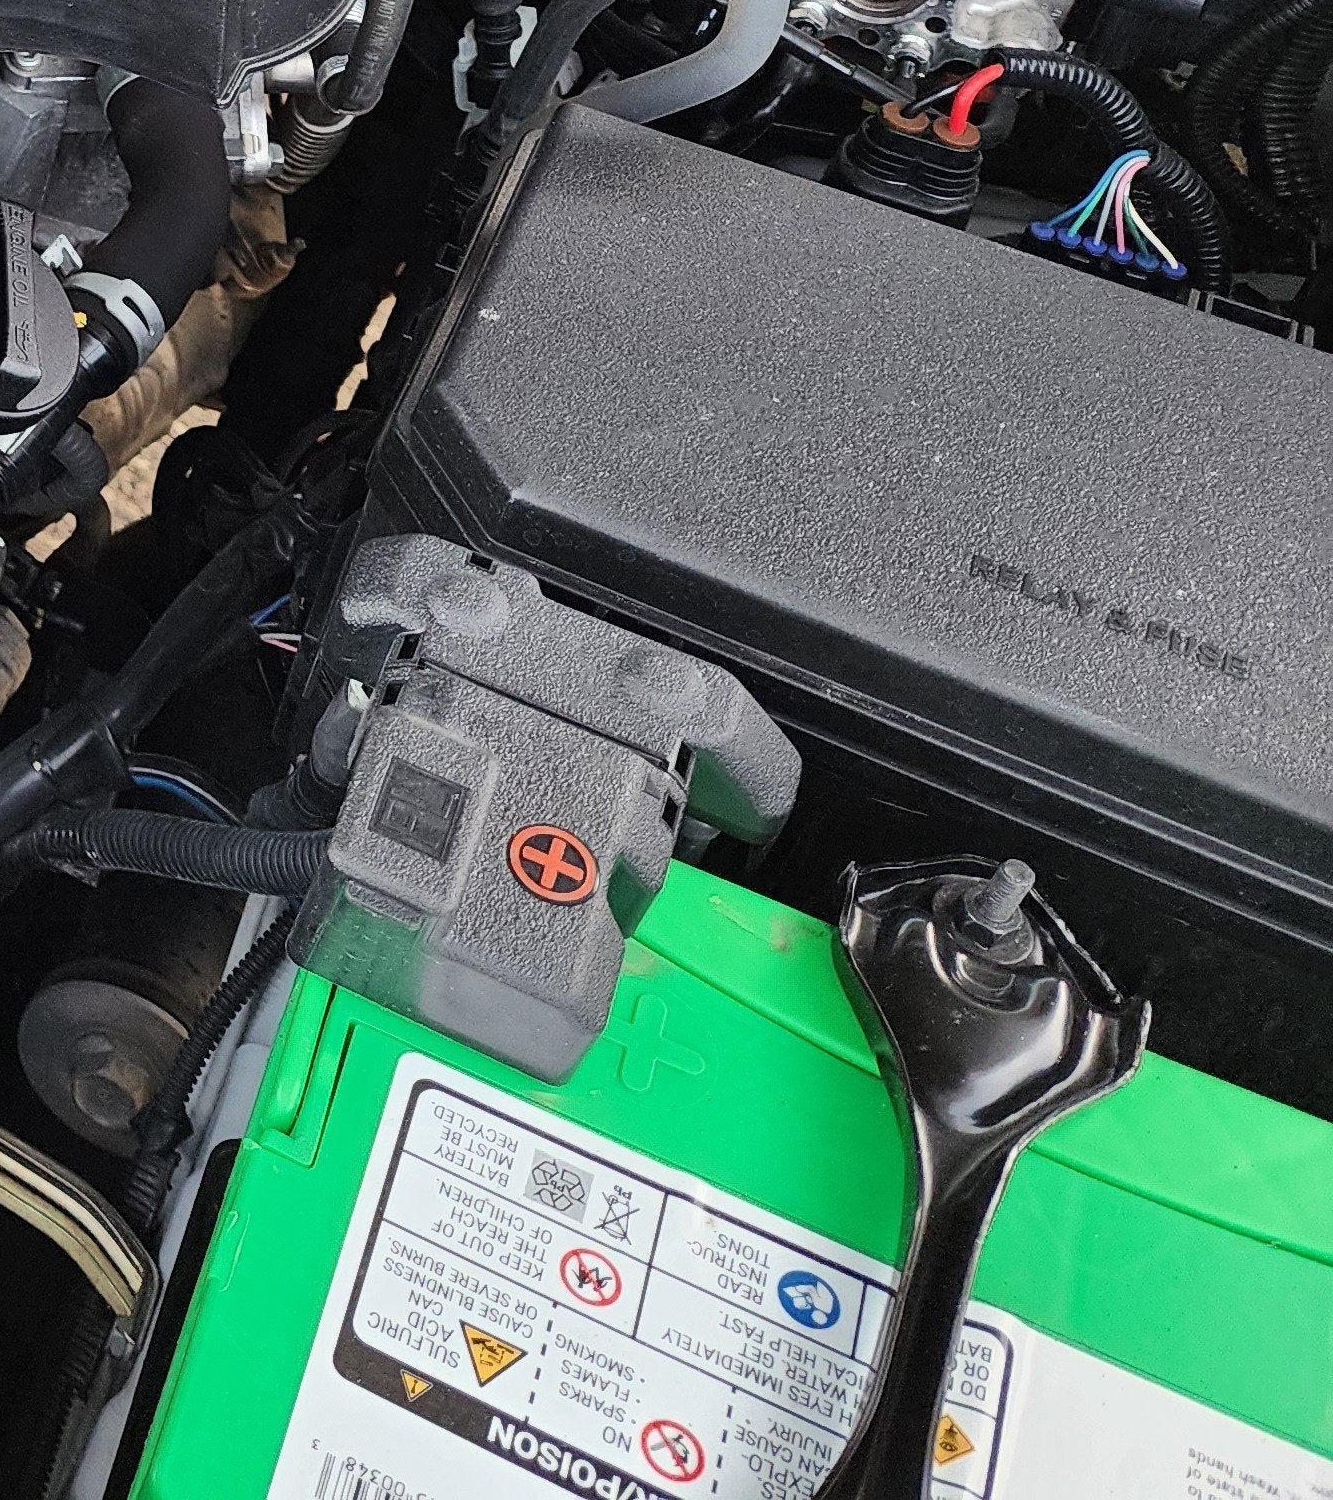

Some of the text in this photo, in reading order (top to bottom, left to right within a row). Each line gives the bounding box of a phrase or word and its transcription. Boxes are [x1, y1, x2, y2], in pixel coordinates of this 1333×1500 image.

[8, 206, 29, 307] ENGINE OIL
[968, 553, 1093, 615] RELAY
[431, 1102, 518, 1153] RECYCLED.
[440, 1125, 514, 1170] MUST BE
[433, 1144, 509, 1188] BATTERY
[436, 1179, 552, 1244] OF CHILDREN.
[430, 1219, 544, 1281] KEEP OUT OF
[451, 1206, 547, 1264] THE REACH
[713, 1226, 768, 1269] TIONS.
[388, 1237, 537, 1320] OR SEVERE BURNS.
[686, 1241, 767, 1287] INSTRUC-
[383, 1257, 533, 1338] CAUSE BLINDNESS
[408, 1289, 443, 1316] CAN
[718, 1274, 764, 1305] READ
[367, 1312, 460, 1368] SULFURIC
[408, 1311, 454, 1342] ACID
[719, 1311, 765, 1344] FAST.
[555, 1334, 635, 1381] SMOKING
[661, 1328, 831, 1416] EYES IMMEDIATELY
[738, 1343, 775, 1369] GET
[770, 1339, 816, 1368] HELP
[960, 1359, 990, 1381] OR
[559, 1381, 626, 1422] SPARKS
[561, 1359, 630, 1402] FLAMES
[782, 1360, 847, 1404] WATER.
[958, 1378, 988, 1401] DO
[309, 1436, 322, 1450] 3
[603, 1426, 632, 1453] NO
[732, 1424, 830, 1479] AN CAUSE
[741, 1454, 814, 1497] EXPLO-
[1185, 1447, 1235, 1478] hands
[1185, 1466, 1202, 1482] of
